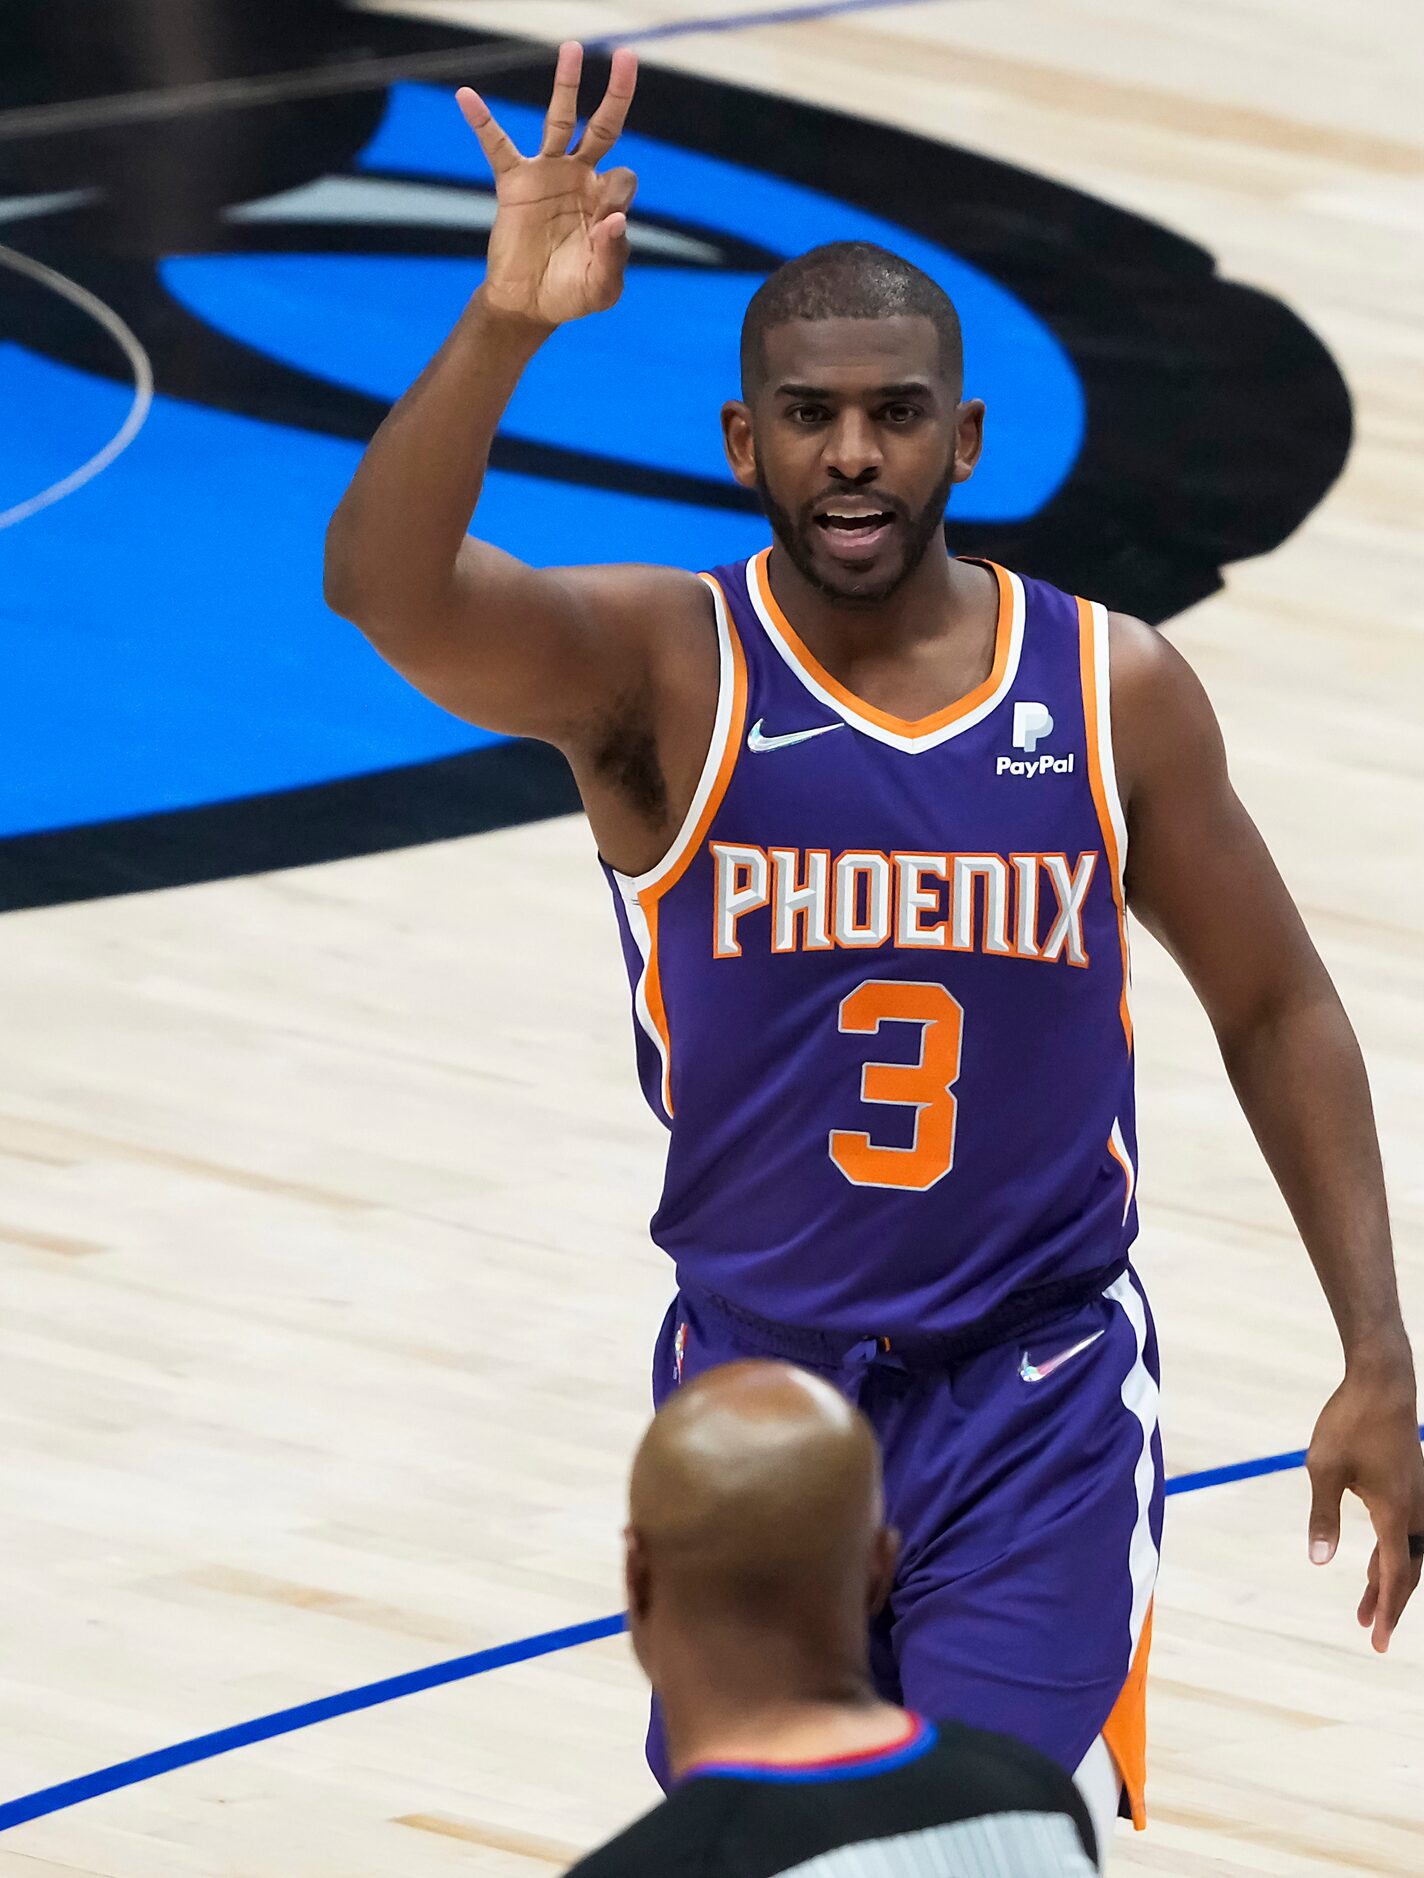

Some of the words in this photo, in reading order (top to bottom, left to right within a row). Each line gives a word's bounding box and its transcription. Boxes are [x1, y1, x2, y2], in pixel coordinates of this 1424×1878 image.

[996, 754, 1074, 778] PayPal
[709, 841, 1098, 968] PHOENIX
[829, 980, 964, 1191] 3
